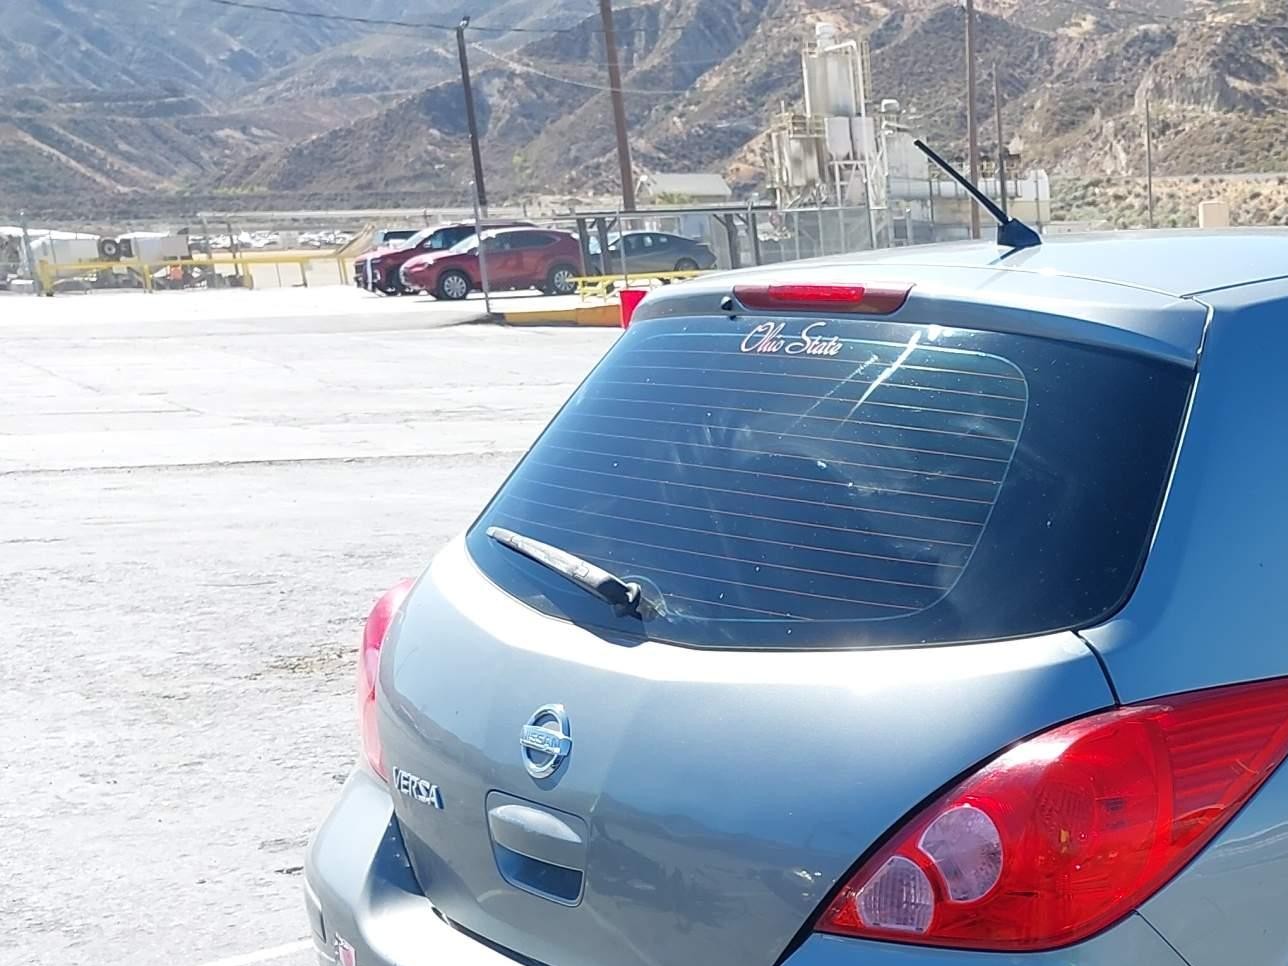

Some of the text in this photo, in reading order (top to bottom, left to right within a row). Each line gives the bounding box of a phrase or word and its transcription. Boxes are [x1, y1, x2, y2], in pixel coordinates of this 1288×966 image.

[741, 321, 843, 356] Ohio State
[522, 728, 561, 748] NISSAN
[393, 766, 444, 810] VERSA
